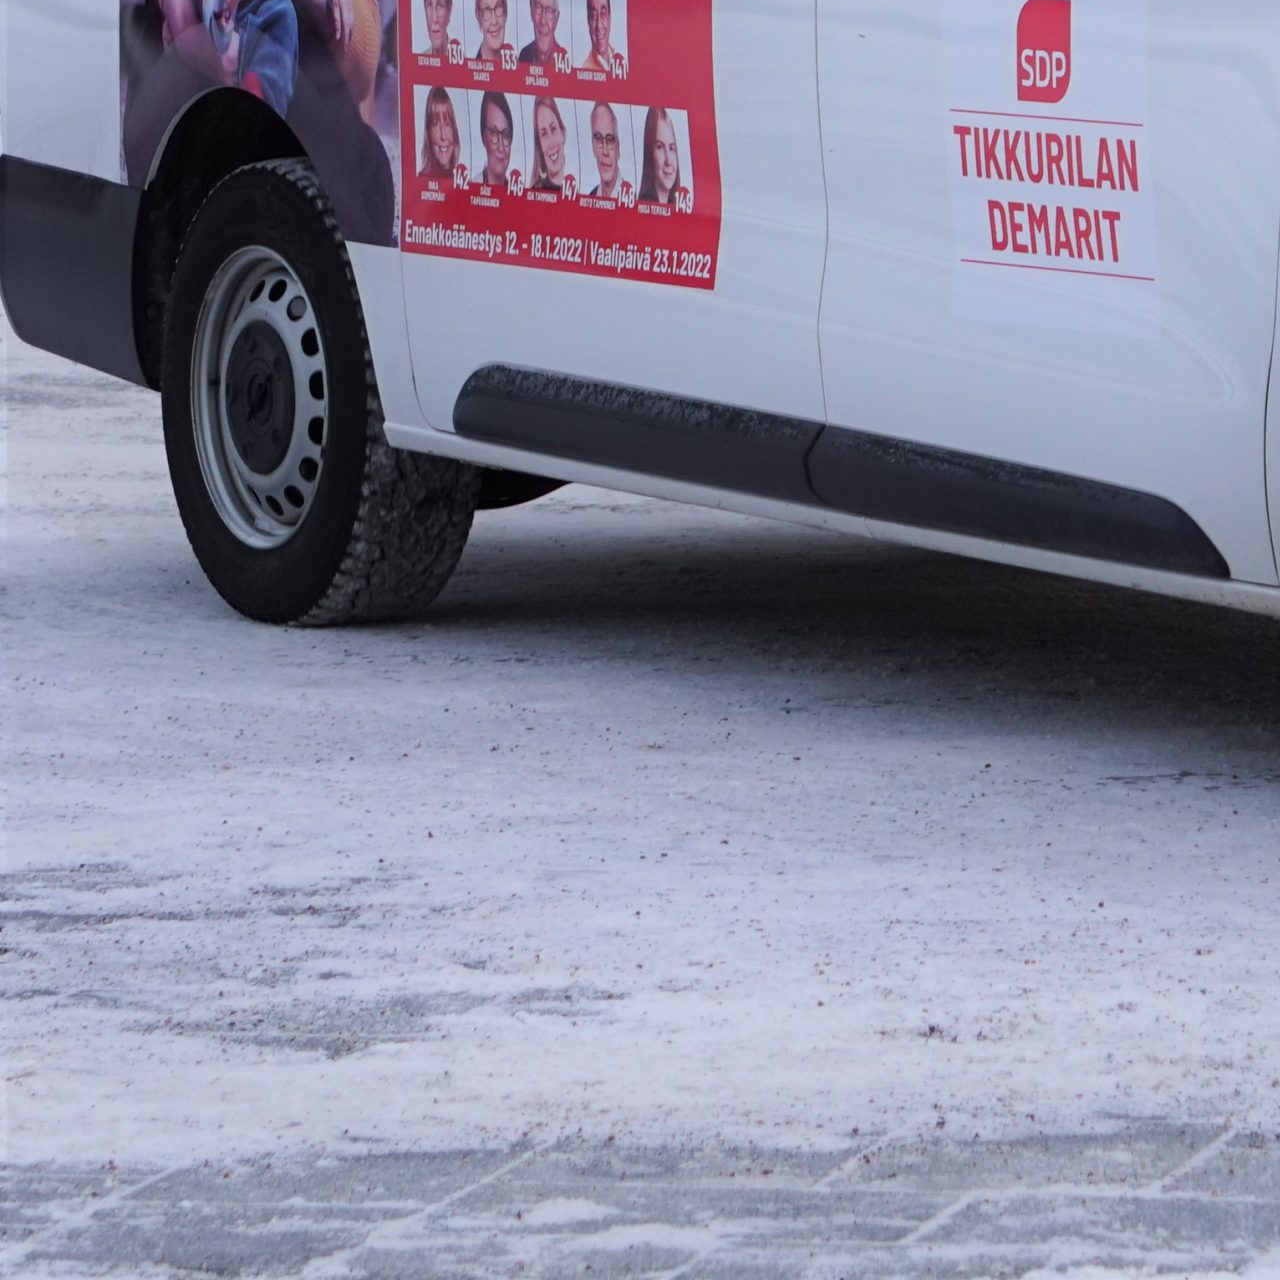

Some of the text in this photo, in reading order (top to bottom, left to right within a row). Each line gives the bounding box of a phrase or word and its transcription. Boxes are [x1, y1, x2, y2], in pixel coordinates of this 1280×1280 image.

[448, 44, 464, 65] 130
[500, 49, 517, 70] 133
[554, 52, 571, 74] 140
[612, 58, 627, 80] 141
[1020, 48, 1067, 89] SDP
[953, 125, 1139, 192] TIKKURILAN
[452, 168, 469, 190] 142
[507, 174, 523, 197] 146
[562, 179, 577, 201] 147
[617, 185, 634, 208] 148
[675, 190, 693, 213] 149
[987, 199, 1121, 263] DEMARIT
[405, 219, 502, 257] Ennakkoäänestys
[504, 230, 519, 255] 12.
[530, 233, 582, 263] 18.1.2022
[589, 243, 651, 273] Vaalipäivä
[653, 248, 711, 279] 23.1.2022
